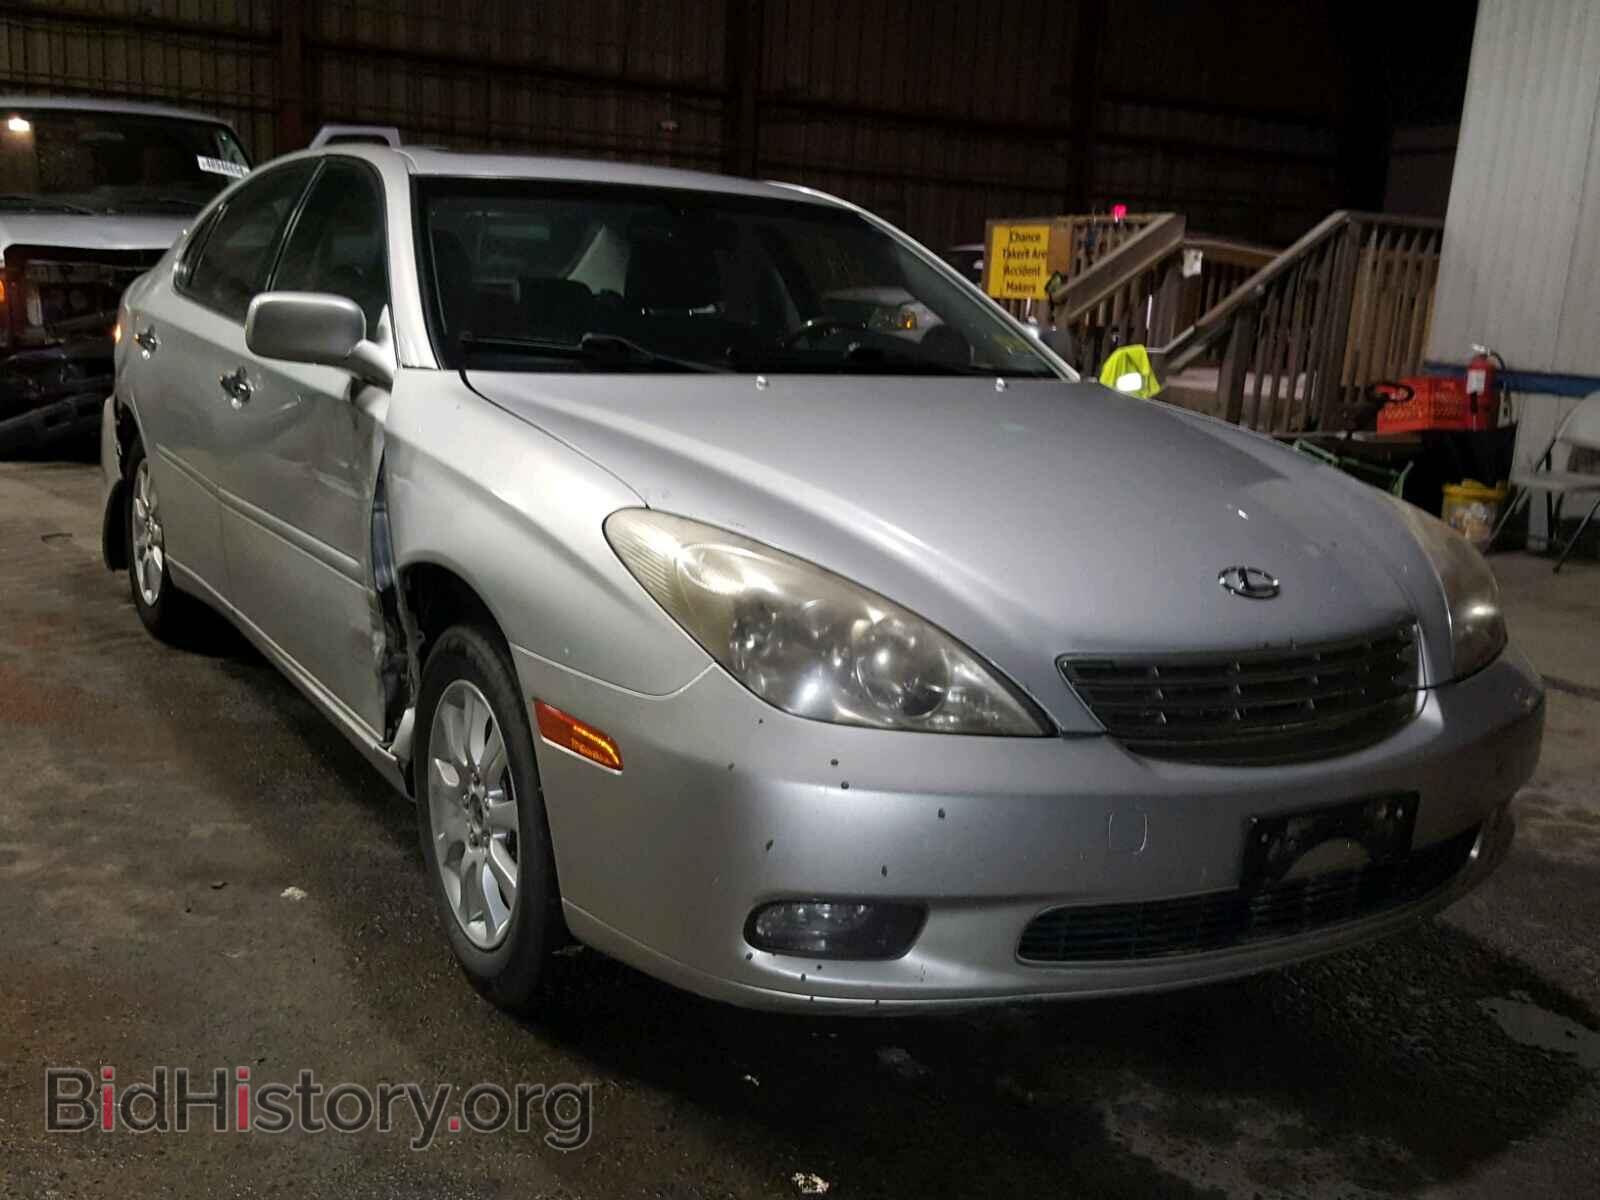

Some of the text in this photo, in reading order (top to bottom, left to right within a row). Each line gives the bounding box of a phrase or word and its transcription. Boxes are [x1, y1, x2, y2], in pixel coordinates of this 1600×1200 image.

[1009, 230, 1041, 242] Chance
[1032, 247, 1047, 258] Are
[1003, 264, 1040, 276] Accident
[1006, 281, 1036, 292] Makers
